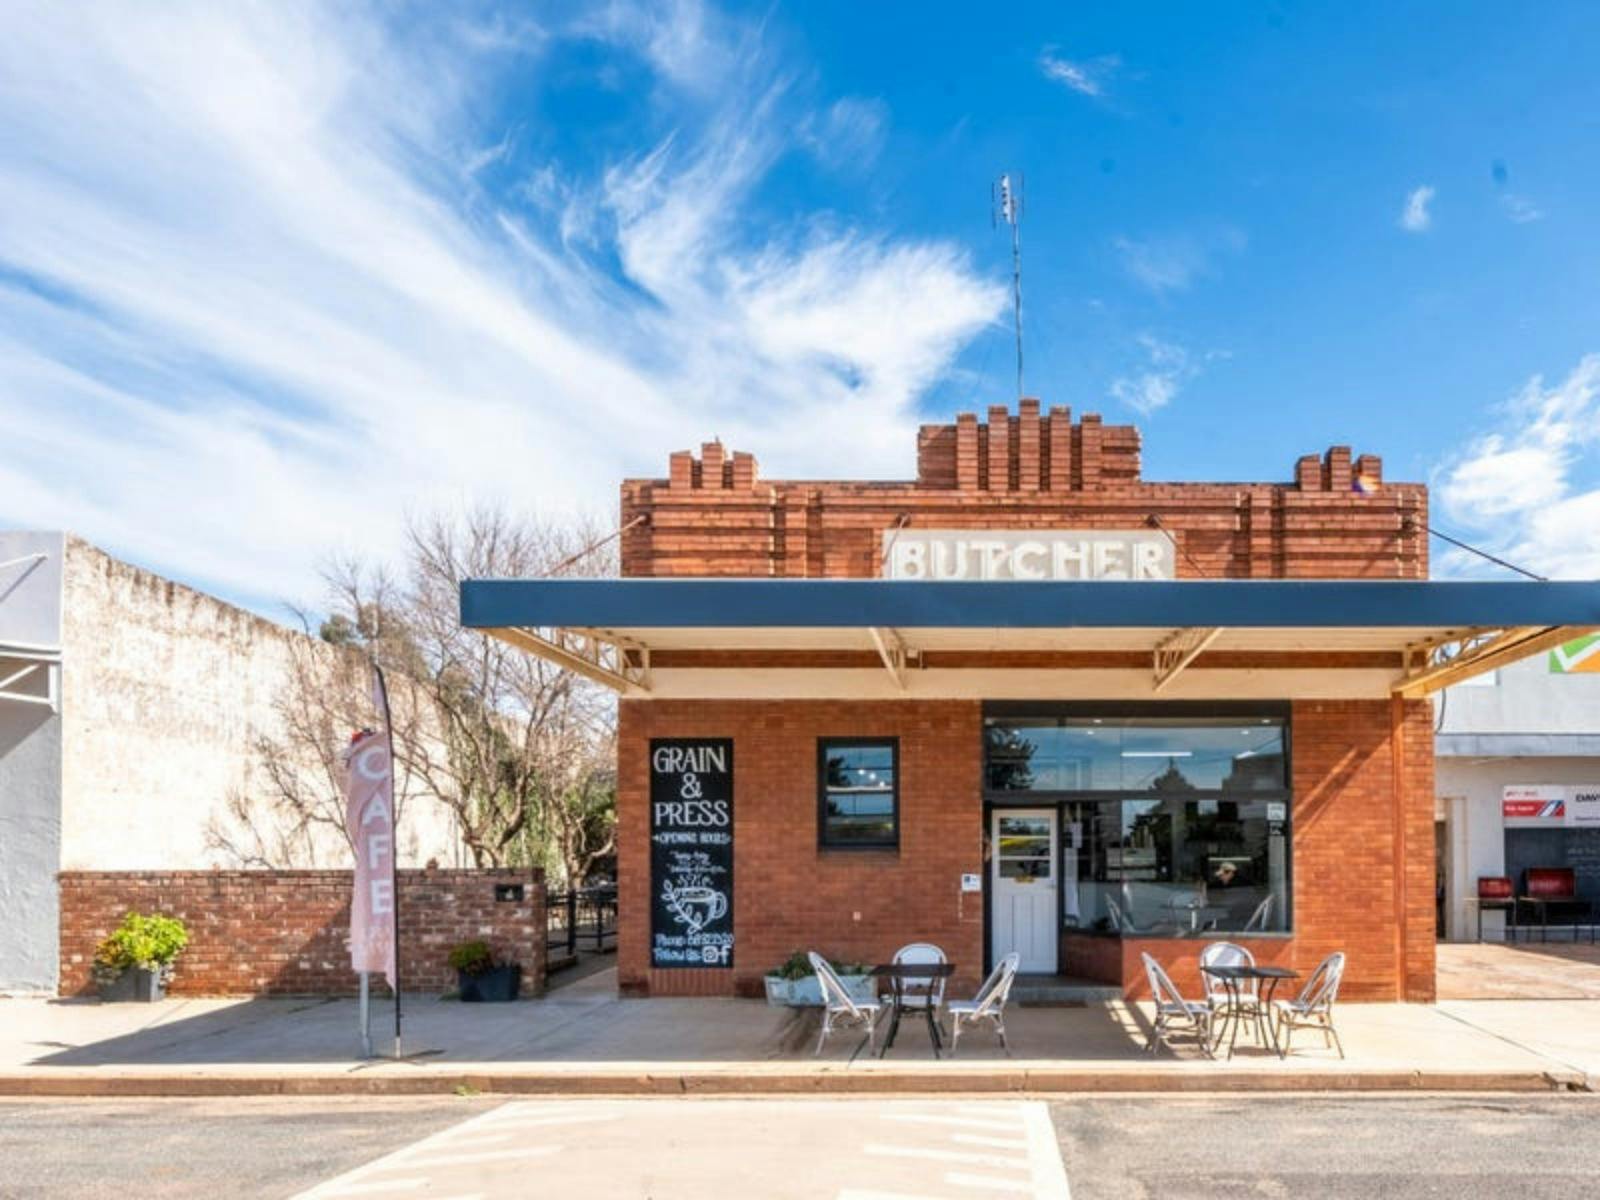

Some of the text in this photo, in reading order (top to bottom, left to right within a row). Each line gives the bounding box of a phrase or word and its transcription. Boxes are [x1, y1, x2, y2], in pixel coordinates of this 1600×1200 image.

[890, 540, 1166, 581] BUTCHER
[653, 746, 727, 773] GRAIN
[680, 772, 702, 798] &
[655, 800, 729, 826] PRESS
[357, 746, 392, 914] CAFE
